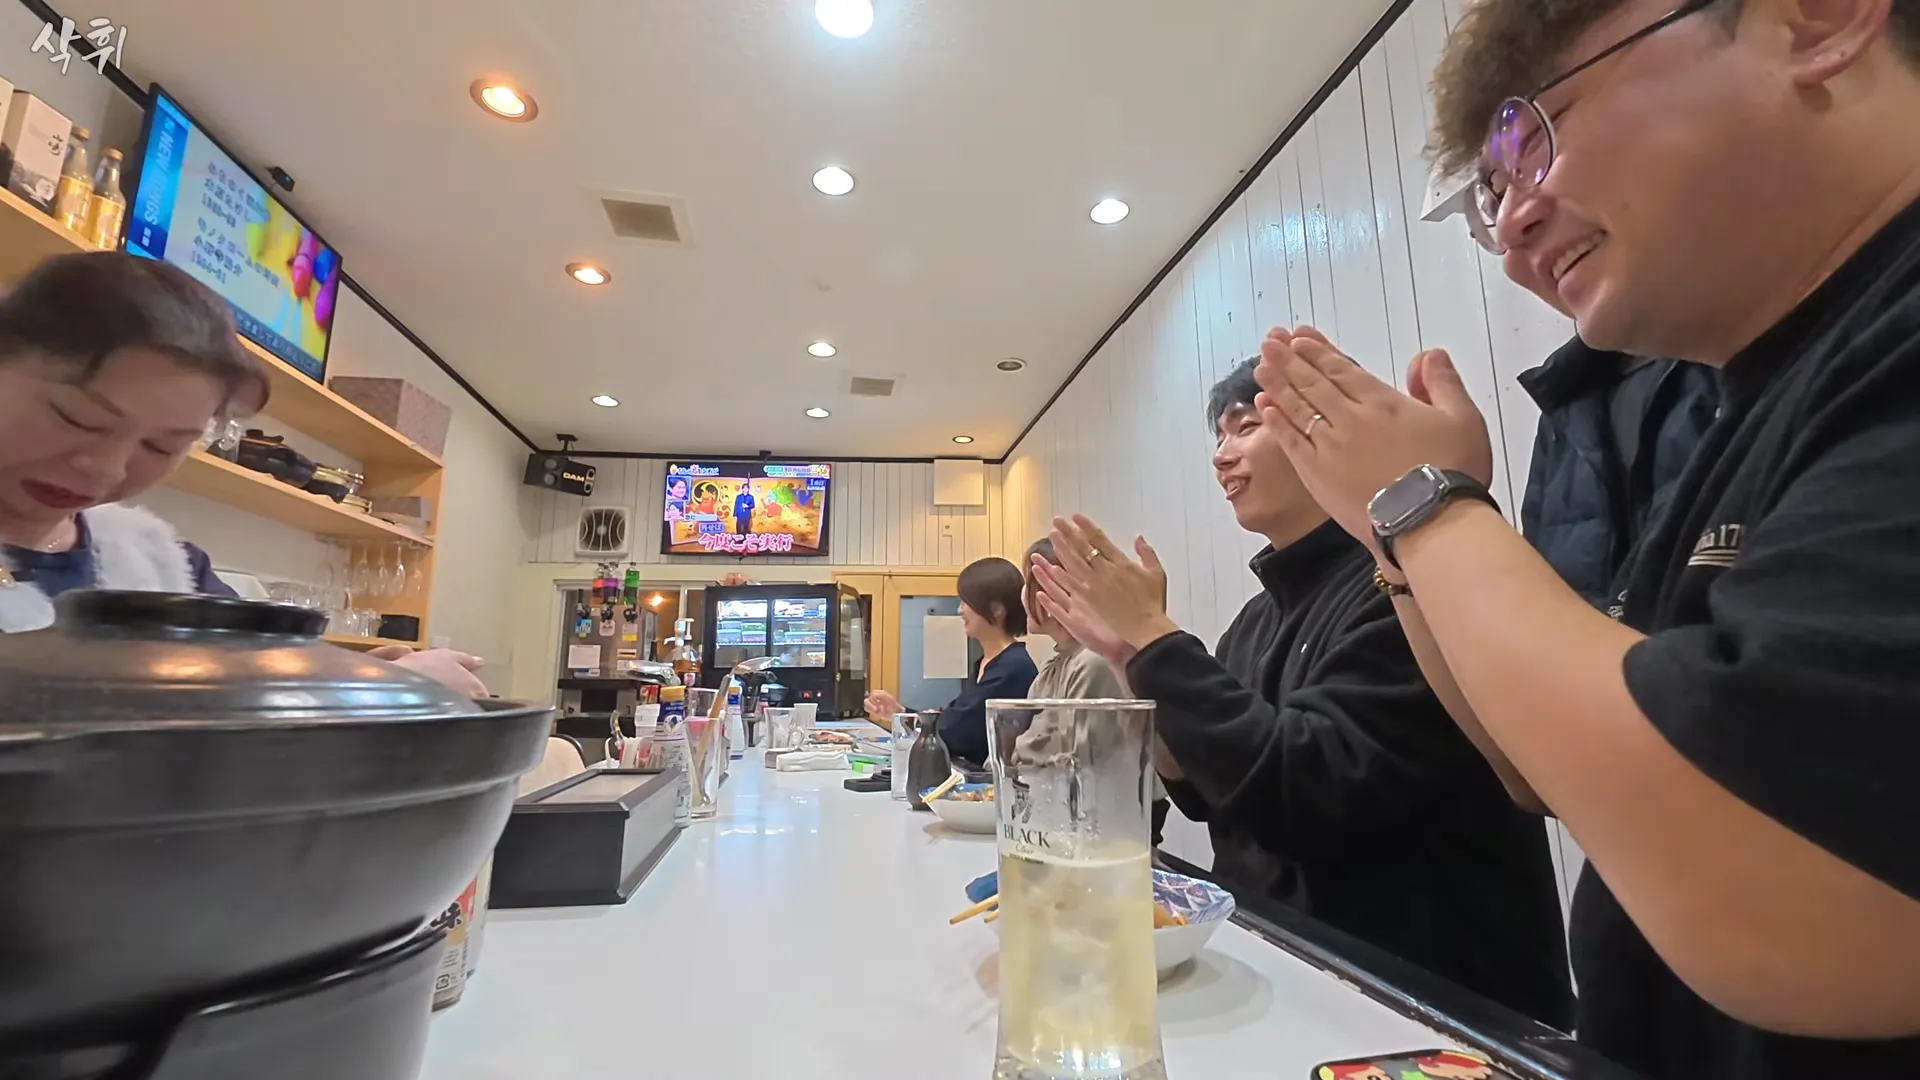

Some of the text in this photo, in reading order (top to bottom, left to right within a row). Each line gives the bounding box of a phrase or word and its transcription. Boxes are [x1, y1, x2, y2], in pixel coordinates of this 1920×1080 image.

[155, 131, 175, 171] NEW
[563, 472, 585, 482] DAM
[698, 532, 794, 552] 今度こそ実行
[1004, 823, 1051, 849] BLACK
